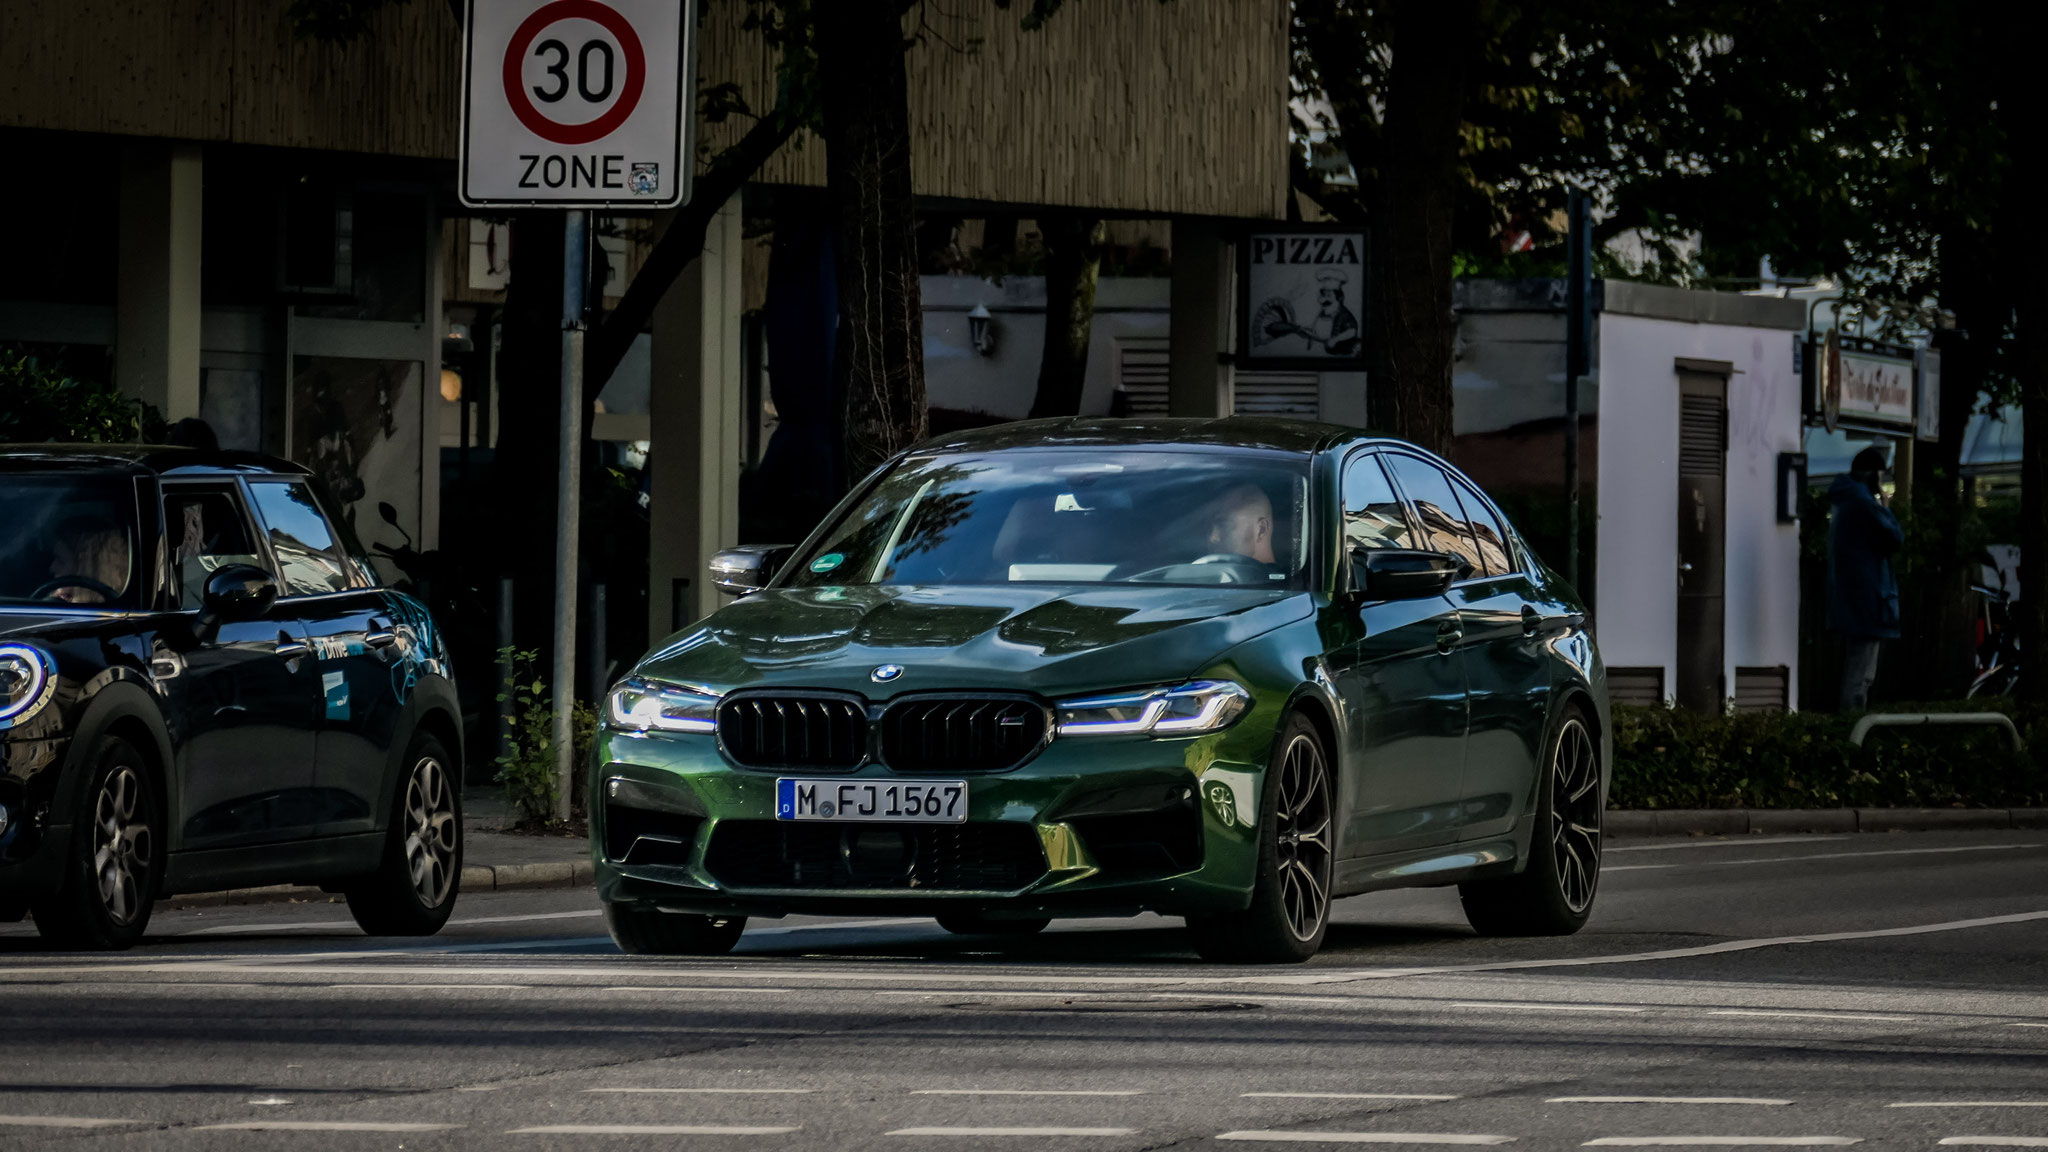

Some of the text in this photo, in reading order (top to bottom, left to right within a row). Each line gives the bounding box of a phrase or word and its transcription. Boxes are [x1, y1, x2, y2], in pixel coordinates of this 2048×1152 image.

[533, 39, 613, 102] 30
[518, 155, 624, 188] ZONE
[1253, 238, 1359, 264] PIZZA
[798, 785, 816, 815] M
